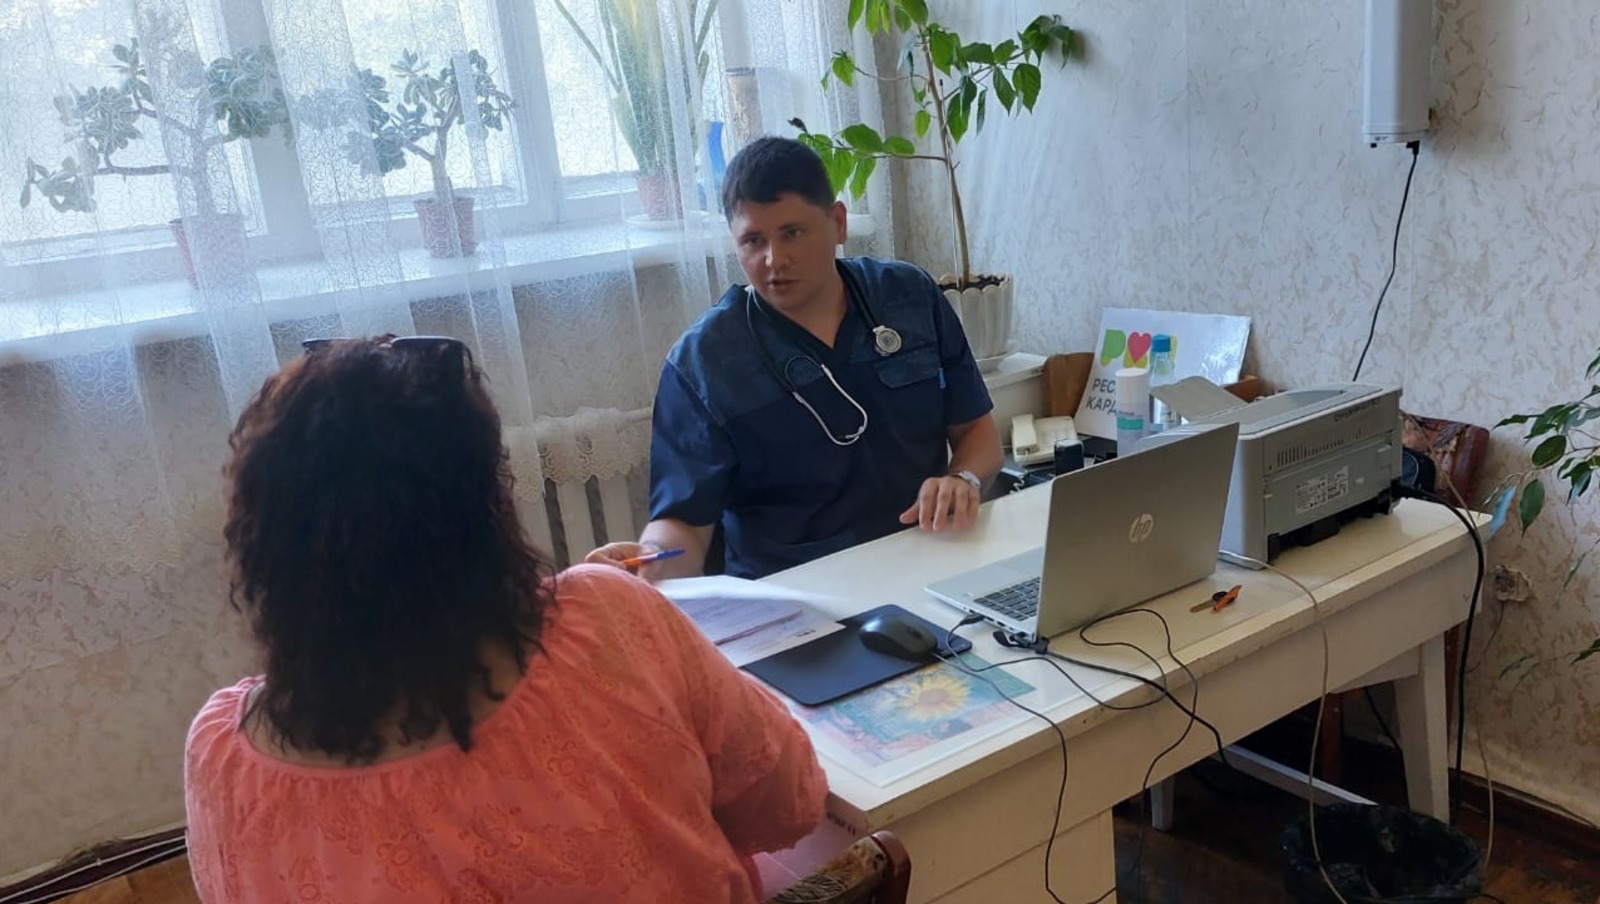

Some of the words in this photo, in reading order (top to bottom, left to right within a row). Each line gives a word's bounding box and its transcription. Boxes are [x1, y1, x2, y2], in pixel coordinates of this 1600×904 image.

[1092, 378, 1116, 394] РЕС
[1086, 395, 1117, 416] КАРД
[1128, 513, 1154, 543] hp
